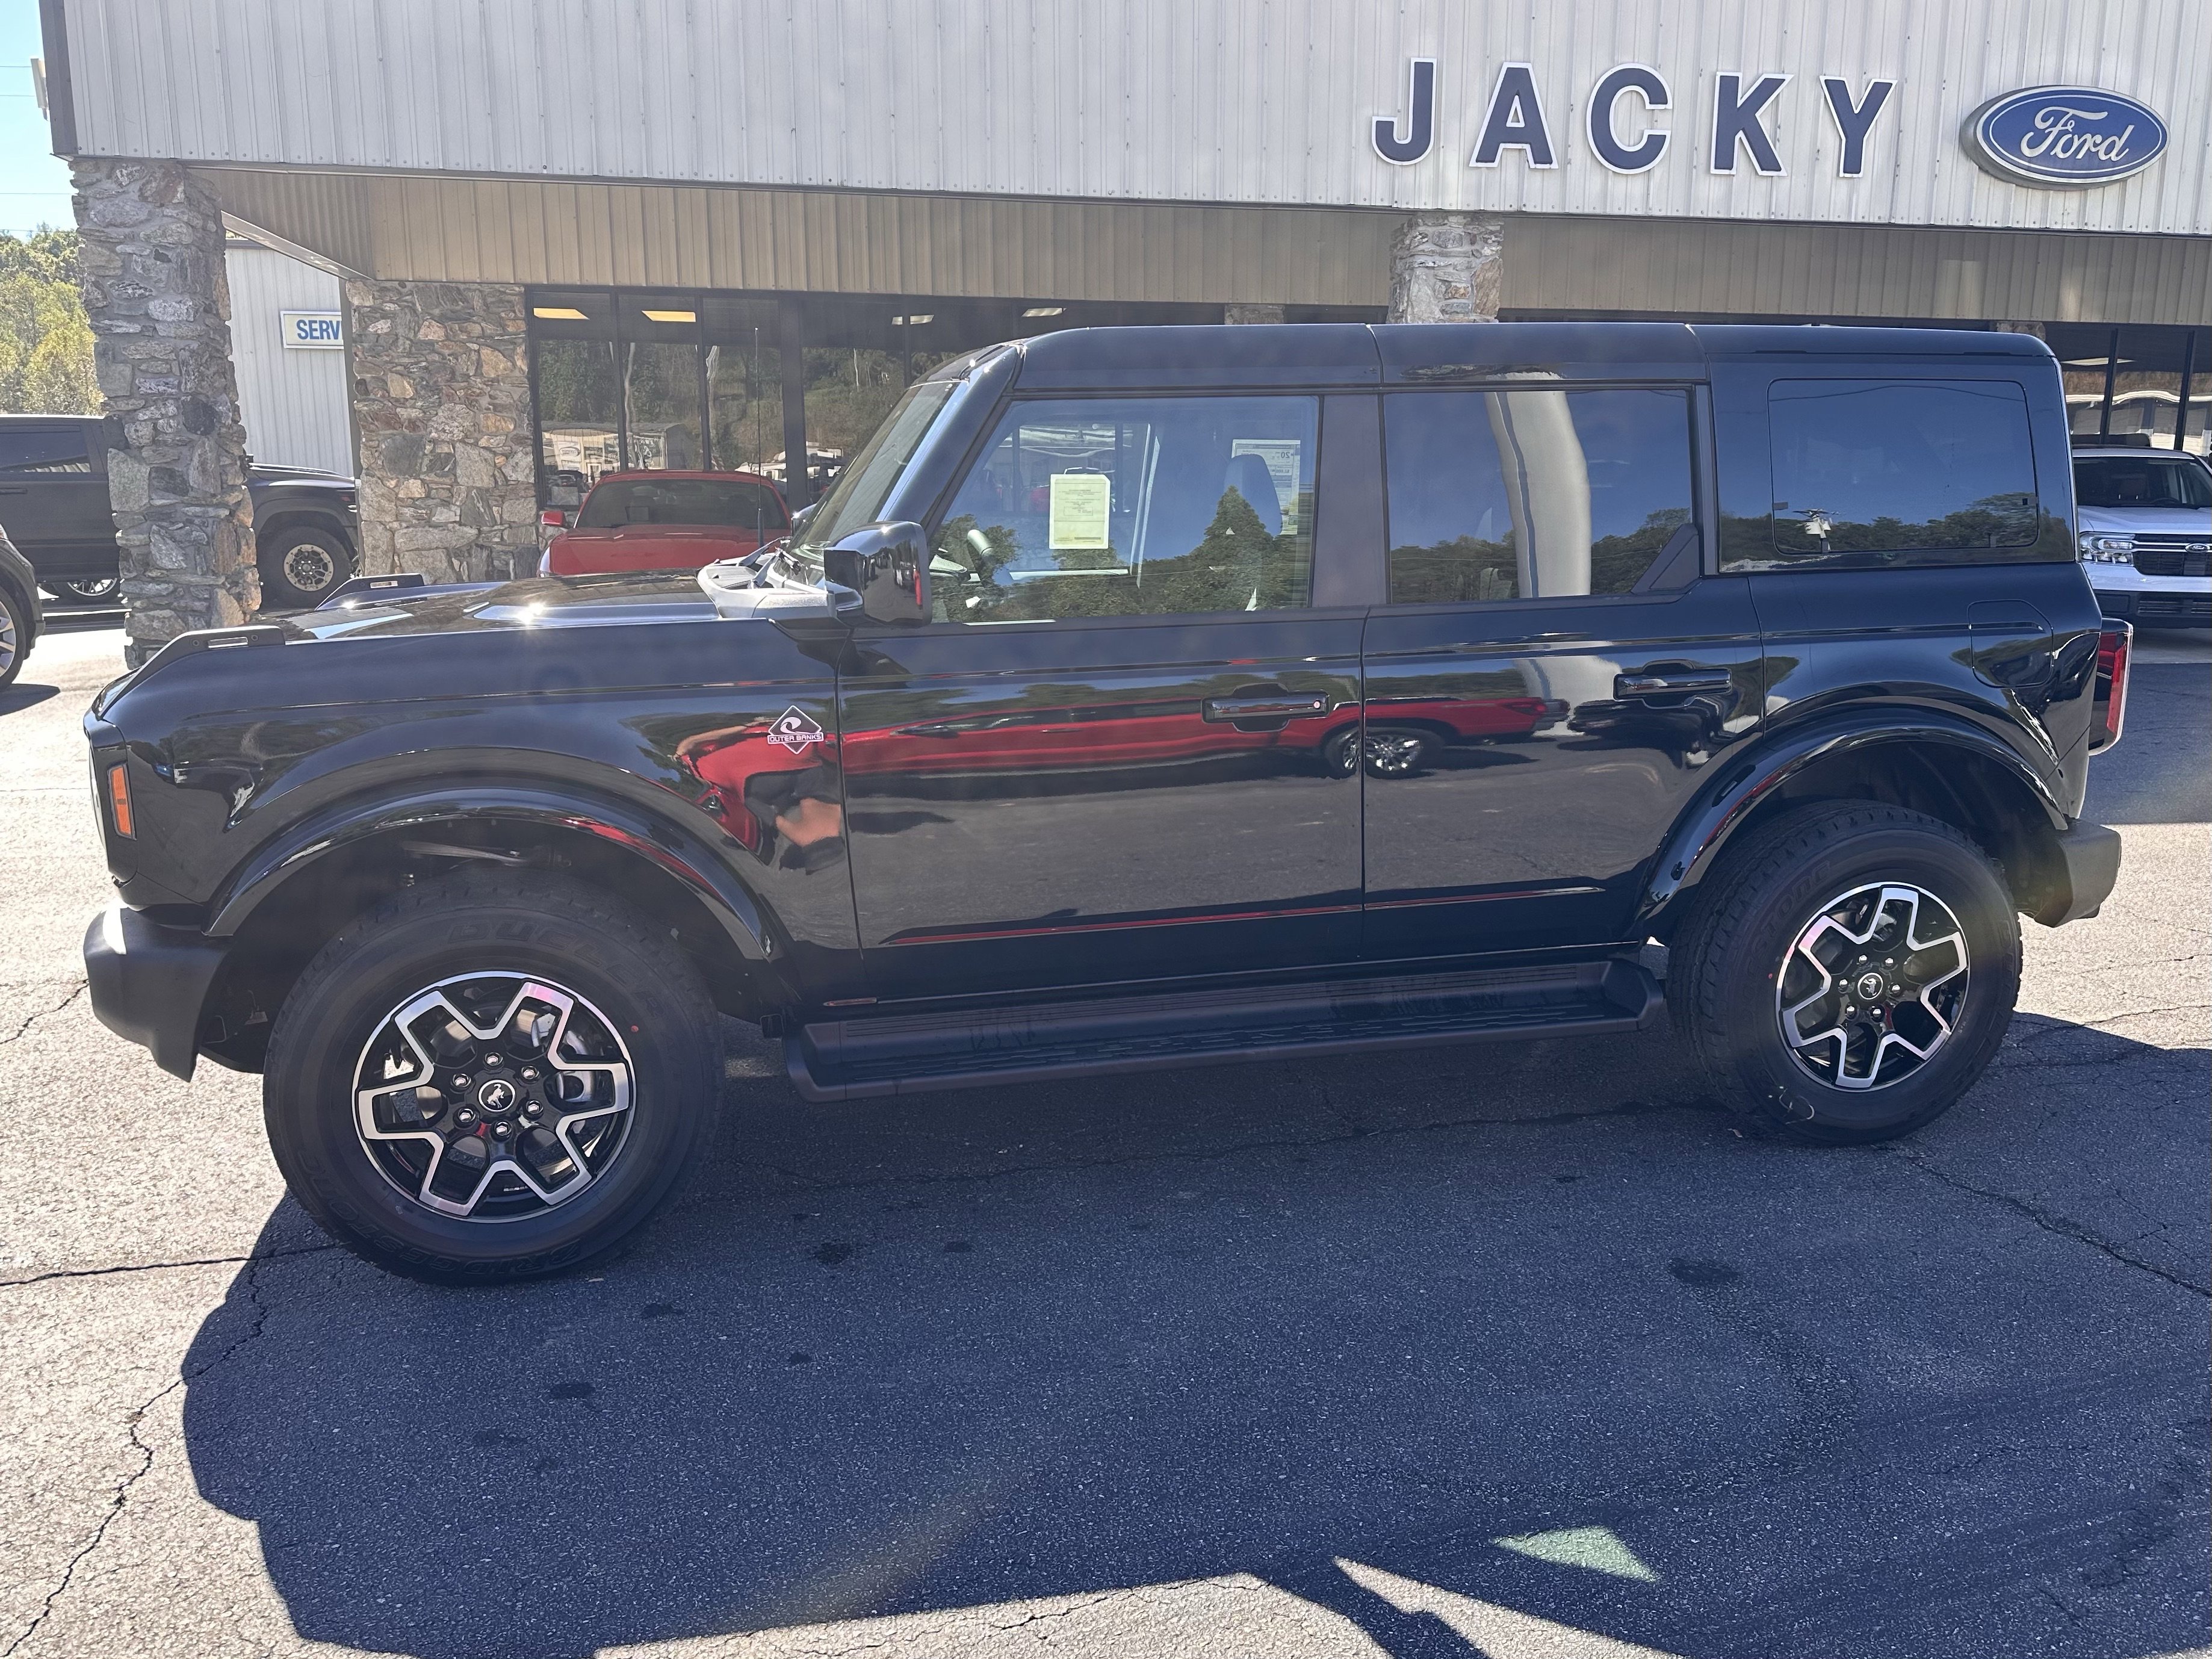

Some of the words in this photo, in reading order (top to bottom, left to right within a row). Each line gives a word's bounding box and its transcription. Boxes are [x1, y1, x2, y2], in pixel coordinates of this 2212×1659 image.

[1372, 57, 1898, 178] JACKY
[2020, 106, 2135, 163] Ford
[296, 318, 340, 340] SERV
